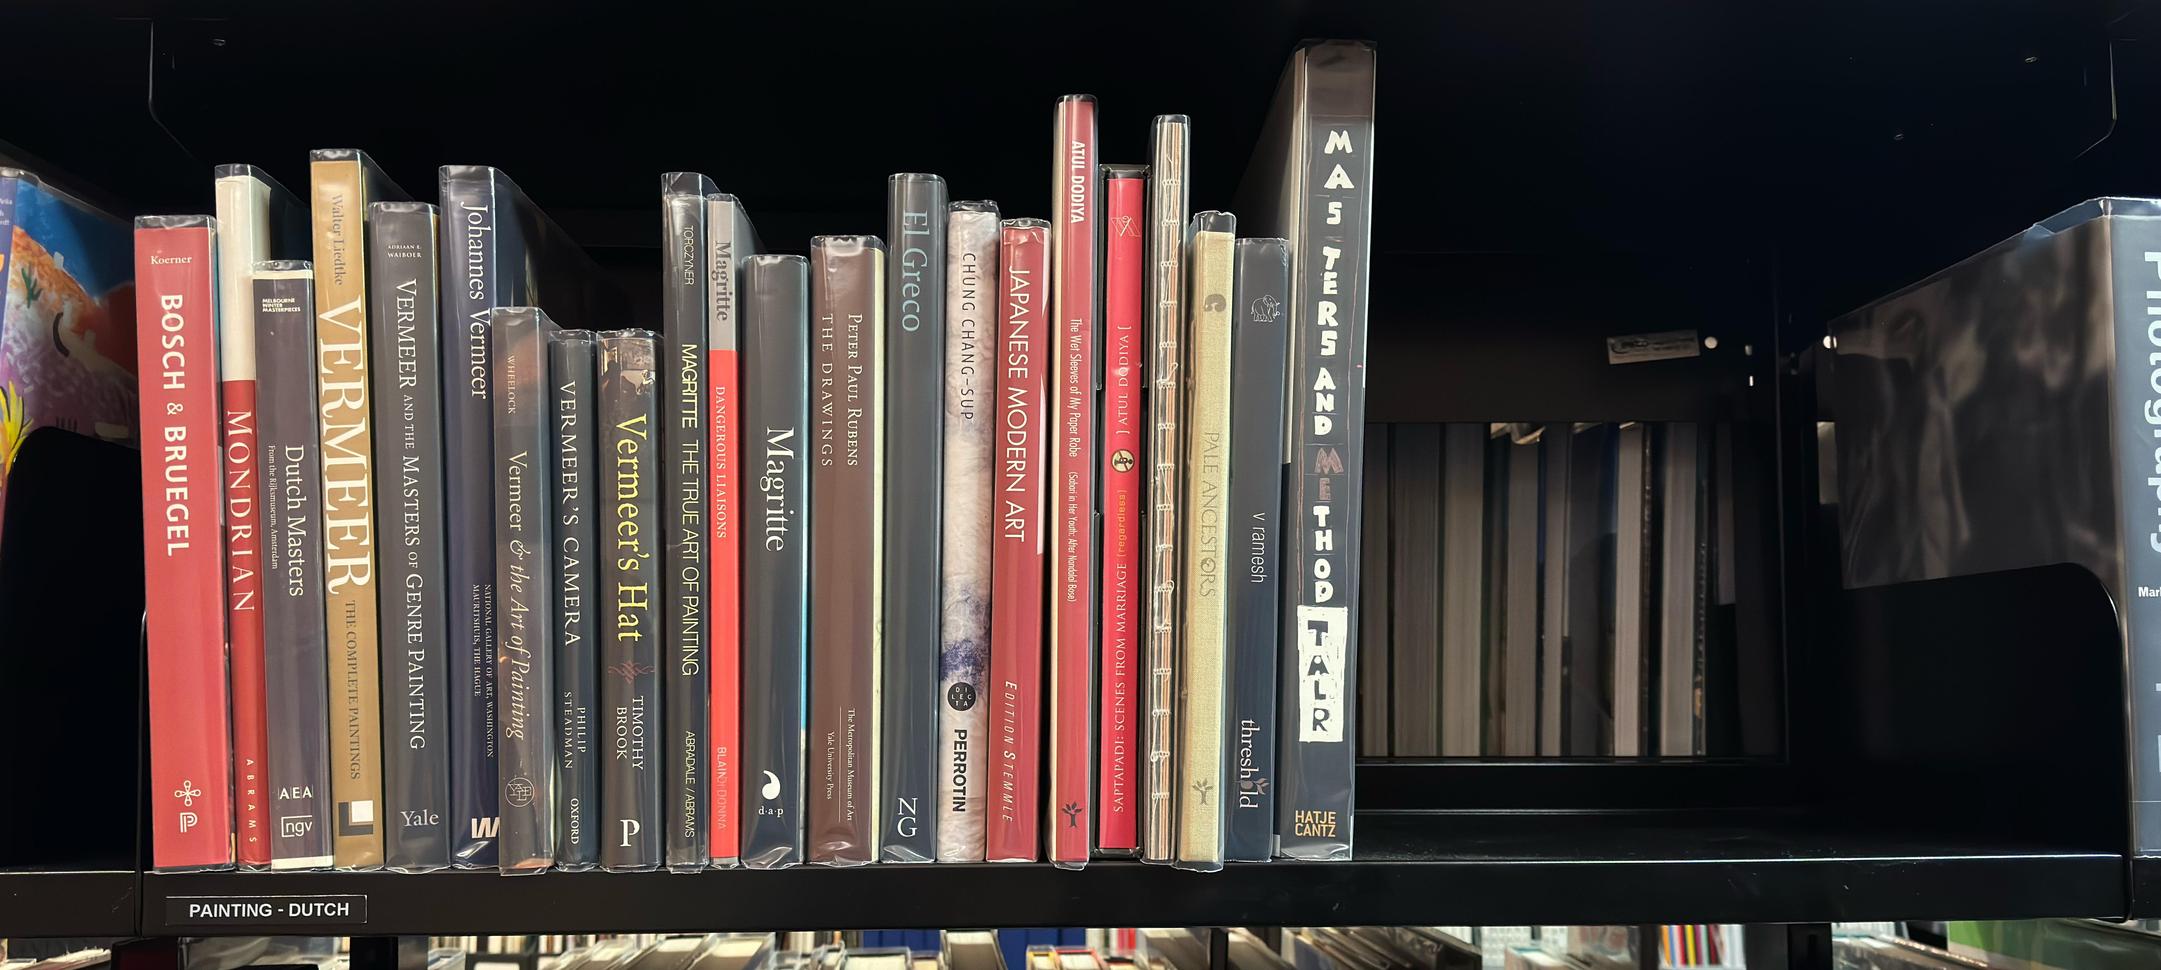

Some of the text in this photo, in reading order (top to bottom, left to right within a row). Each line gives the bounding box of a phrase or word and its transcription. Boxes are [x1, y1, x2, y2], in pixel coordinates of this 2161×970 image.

[1070, 140, 1085, 224] ATUL DODIYA
[150, 255, 192, 265] Koerner
[332, 194, 348, 286] Walter Liedtke
[683, 225, 694, 285] TORCZYNER
[1318, 130, 1355, 356] MASTERS
[461, 202, 492, 399] Johannes Vermeer
[710, 241, 733, 322] Magritte
[902, 212, 930, 333] El Greco
[960, 252, 976, 420] CHUNG CHANG-SUP
[1070, 318, 1082, 333] The
[1070, 335, 1081, 351] Wet
[507, 356, 516, 414] WHEELOCK
[822, 313, 833, 467] THE DRAWINGS
[847, 313, 863, 466] PETER PAUL RUBENS
[1069, 354, 1081, 383] Sleeves
[1070, 386, 1081, 394] of
[1118, 334, 1129, 387] DODIYA
[160, 294, 190, 557] BOSCH & BRUEGEL
[1004, 266, 1030, 542] JAPANESE MODERN ART
[1066, 412, 1080, 434] Paper
[1067, 397, 1080, 410] My
[1117, 393, 1128, 426] ATUL
[1313, 367, 1336, 436] AND
[268, 445, 277, 463] From
[269, 464, 277, 477] the
[318, 294, 371, 595] VERMEER
[716, 386, 727, 538] DANGEROUS LIAISONS
[1069, 437, 1080, 457] Robe
[227, 410, 255, 612] MONDRIAN
[396, 279, 425, 749] VERMEER AND THE MASTERS OF GENRE PAINTING
[509, 451, 527, 531] Vermeer
[682, 343, 700, 676] MAGRITTE THE TRUE ART OF PAINTING
[760, 426, 795, 551] Magritte
[1068, 503, 1077, 515] Her
[1200, 432, 1220, 598] PALE ANCESTORS
[270, 528, 279, 569] Amsterdam
[285, 444, 307, 597] Dutch Masters
[1067, 539, 1077, 553] After
[1251, 512, 1267, 583] v ramesh
[1312, 447, 1344, 603] METHOD
[510, 564, 530, 593] the
[562, 538, 581, 646] CAMERA
[1067, 556, 1077, 582] Nandalal
[1067, 584, 1077, 602] Bose)
[510, 596, 530, 629] Art
[618, 582, 648, 642] Hat
[473, 648, 481, 665] THE
[485, 667, 493, 678] OF
[505, 637, 531, 659] of
[345, 600, 361, 780] THE COMPLETE PAINTINGS
[505, 661, 530, 741] Painting
[1113, 562, 1127, 813] SAPTAPADI: SCENES FROM MARRIAGE
[485, 701, 494, 758] WASHINGTON
[564, 692, 573, 769] STEADMAN
[577, 707, 586, 753] PHILIP
[616, 707, 628, 760] BROOK
[632, 696, 644, 770] TIMOTHY
[685, 731, 695, 784] ABRADALE
[1002, 681, 1018, 823] EDITION STEMMLE
[826, 731, 835, 800] Yale University Press
[846, 708, 856, 821] The Metropolitan Museum of Art
[952, 729, 968, 812] PERROTIN
[247, 758, 257, 843] ABRAMS
[286, 821, 312, 837] ngv
[401, 811, 439, 826] Yale
[570, 798, 580, 845] OXFORD
[685, 794, 695, 838] ABRAMS
[717, 789, 727, 830] DONNA
[1295, 810, 1336, 824] HATJE
[620, 819, 641, 847] P
[1295, 824, 1336, 838] CANTZ
[189, 903, 272, 918] PAINTING
[289, 902, 350, 917] DUTCH
